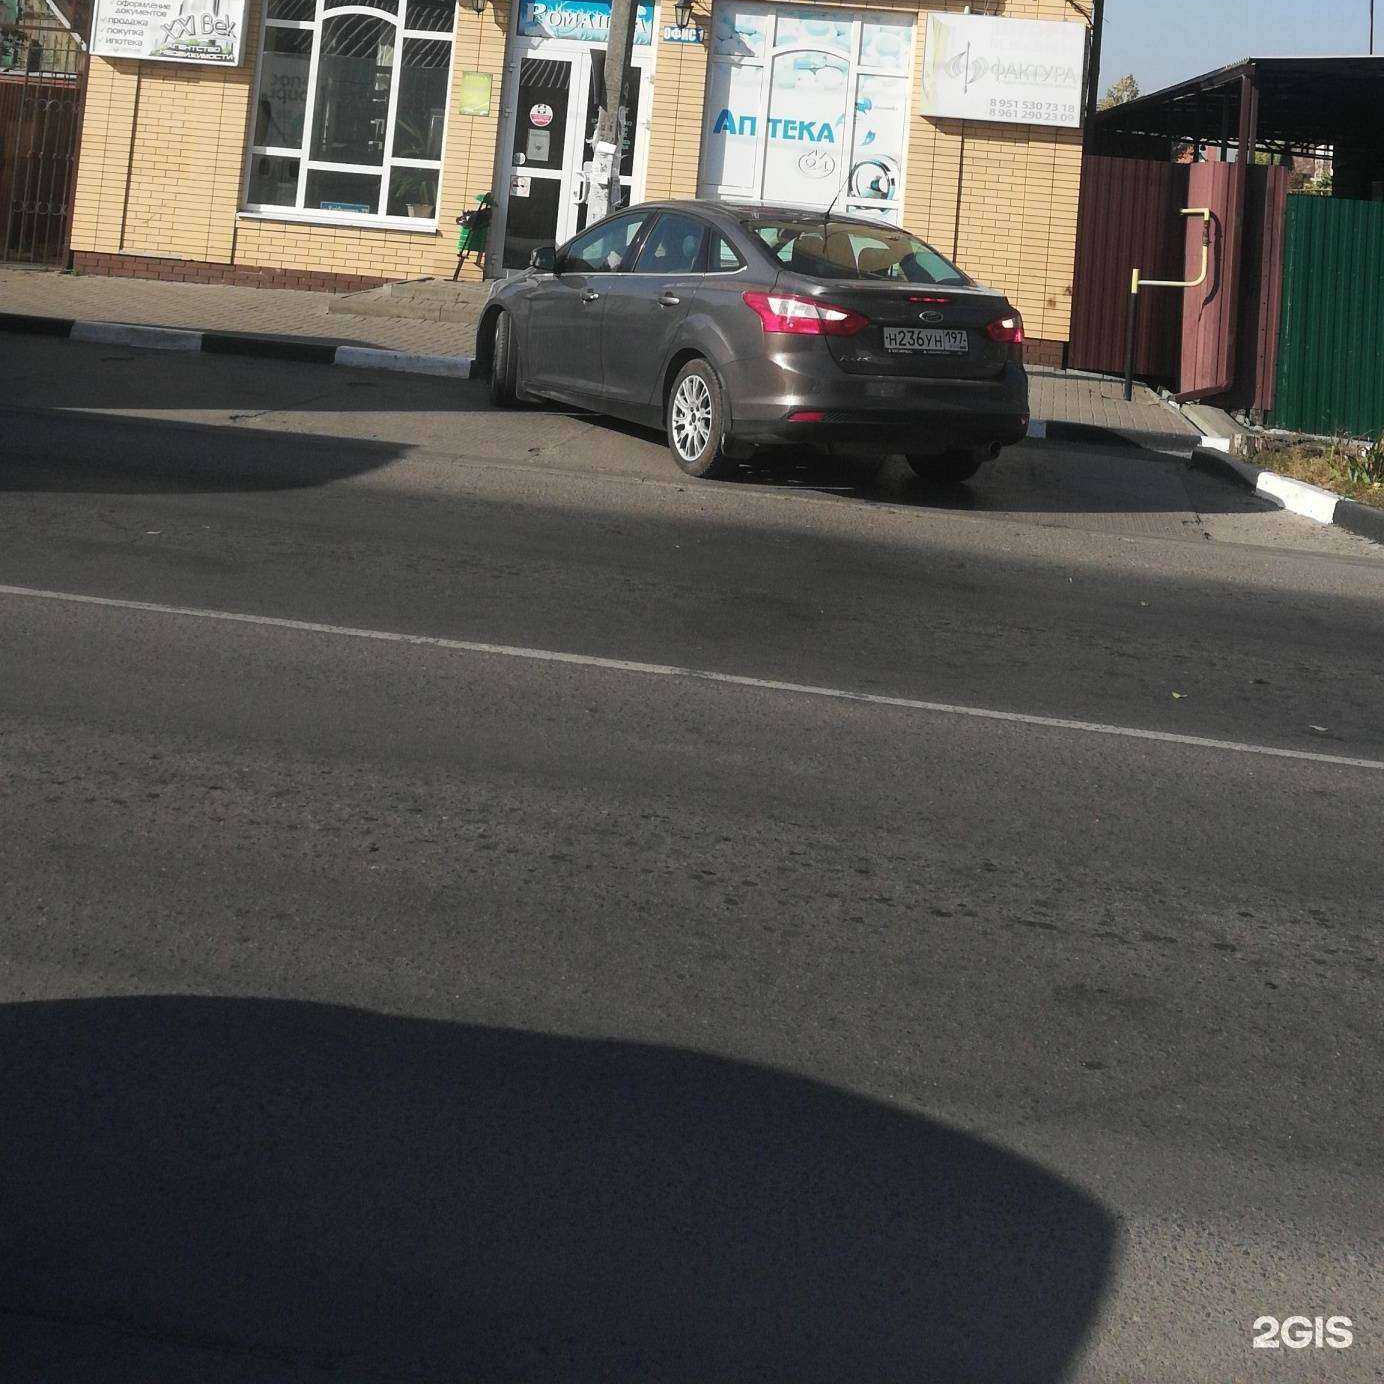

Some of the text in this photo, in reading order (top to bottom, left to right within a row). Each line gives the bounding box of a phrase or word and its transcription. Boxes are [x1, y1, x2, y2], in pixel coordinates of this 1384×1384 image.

[107, 17, 149, 27] продажа
[106, 28, 144, 37] покупка
[663, 26, 697, 42] ОФИС
[990, 98, 997, 107] 8
[998, 99, 1019, 108] 951
[1022, 100, 1043, 110] 530
[888, 330, 963, 348] Н236УН 197
